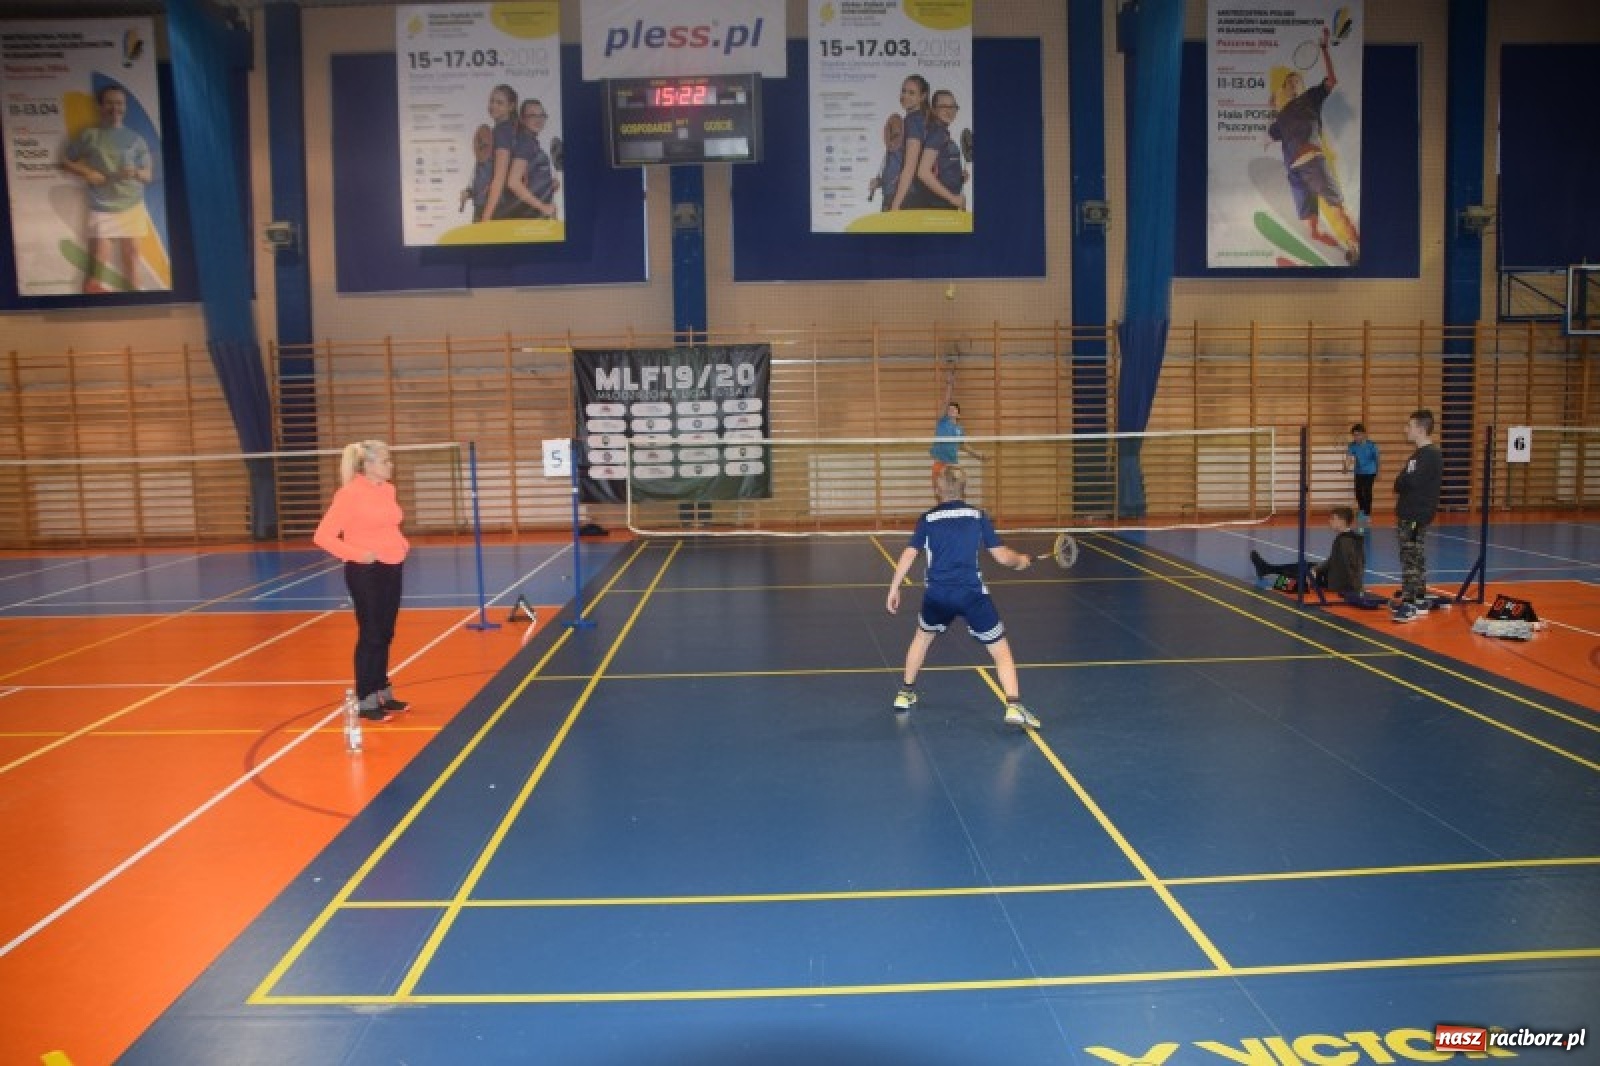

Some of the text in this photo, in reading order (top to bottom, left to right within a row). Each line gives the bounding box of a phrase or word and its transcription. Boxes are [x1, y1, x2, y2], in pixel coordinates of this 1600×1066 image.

[595, 362, 756, 391] MLF19/20
[1513, 435, 1526, 450] 6
[551, 449, 562, 468] 5
